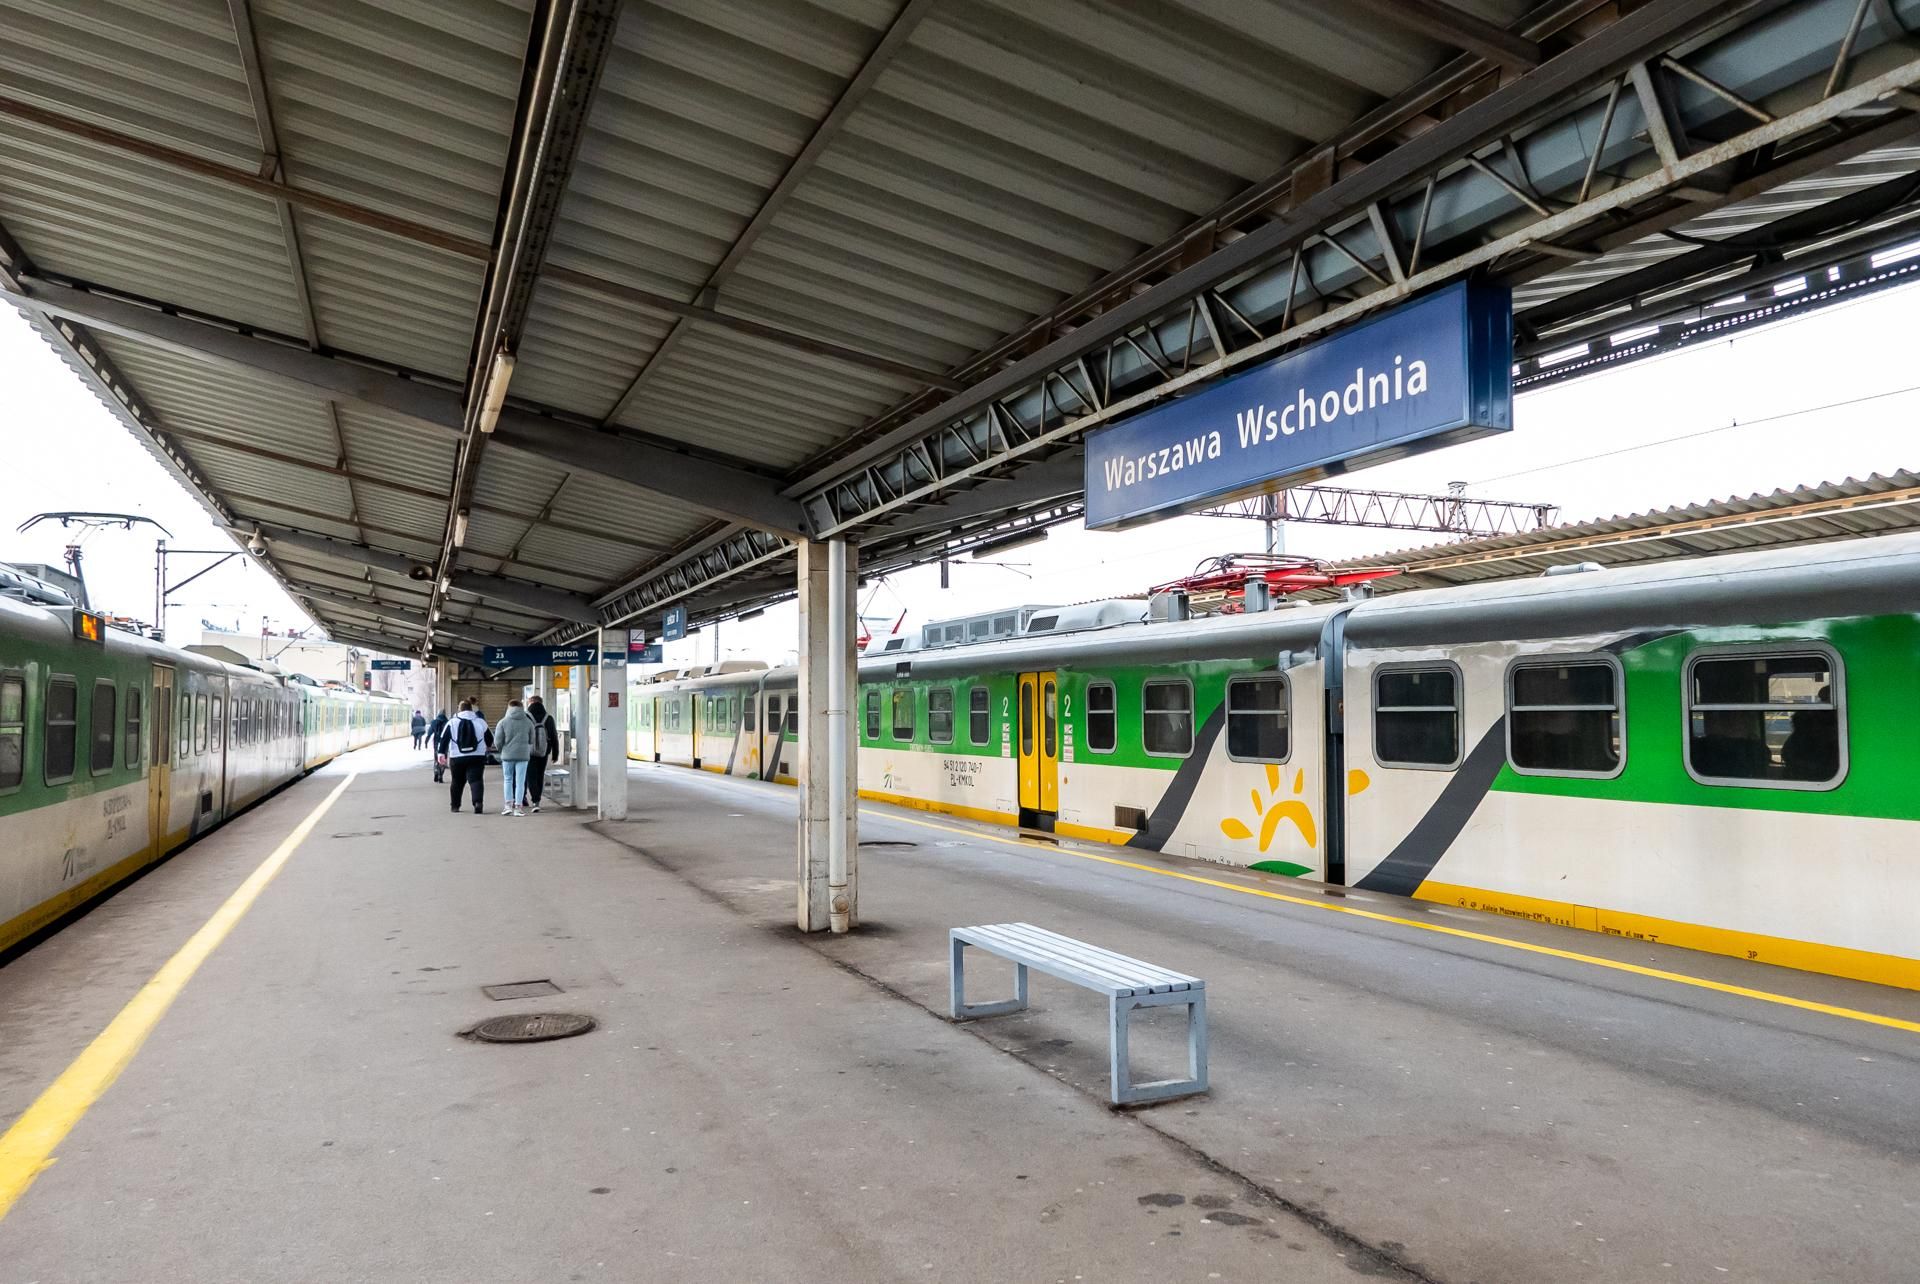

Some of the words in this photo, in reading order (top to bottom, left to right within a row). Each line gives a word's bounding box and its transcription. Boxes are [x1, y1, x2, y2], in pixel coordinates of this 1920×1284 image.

[1104, 430, 1221, 491] Warszawa
[1236, 355, 1428, 449] Wschodnia
[552, 650, 579, 659] peron
[586, 649, 596, 661] 7
[1002, 696, 1009, 717] 2
[1064, 694, 1071, 717] 2
[1747, 950, 1758, 959] 3P
